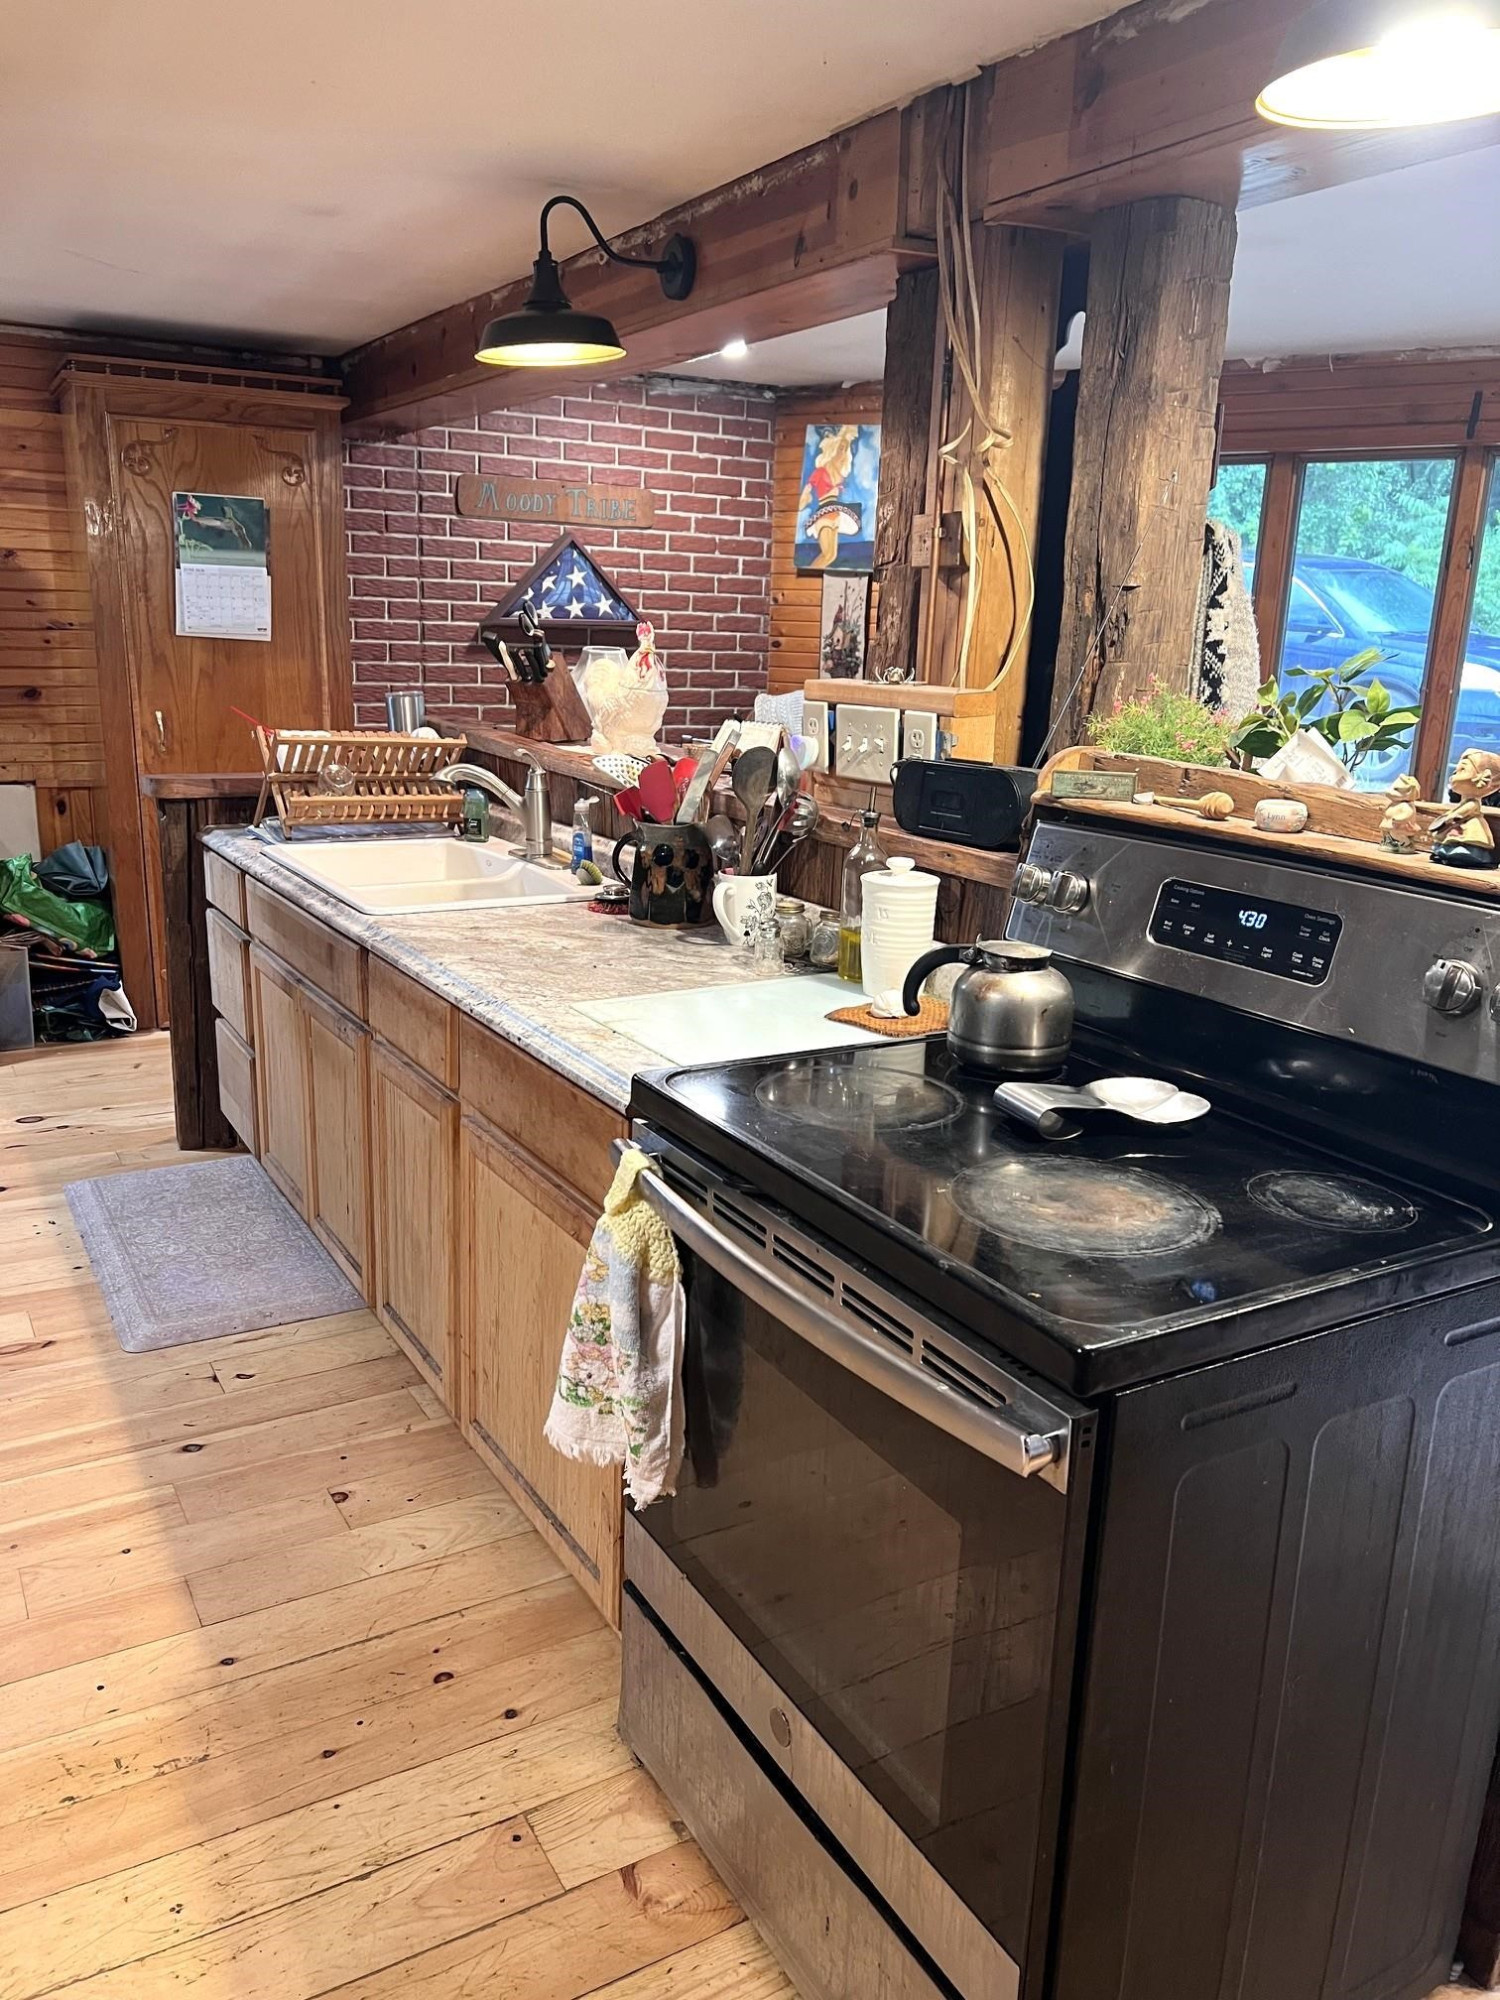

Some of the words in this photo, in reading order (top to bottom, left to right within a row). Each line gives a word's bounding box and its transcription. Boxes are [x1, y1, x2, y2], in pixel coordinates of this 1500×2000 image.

[476, 482, 558, 516] MOODY
[565, 487, 637, 521] TRIBE
[1267, 812, 1286, 822] Lynn
